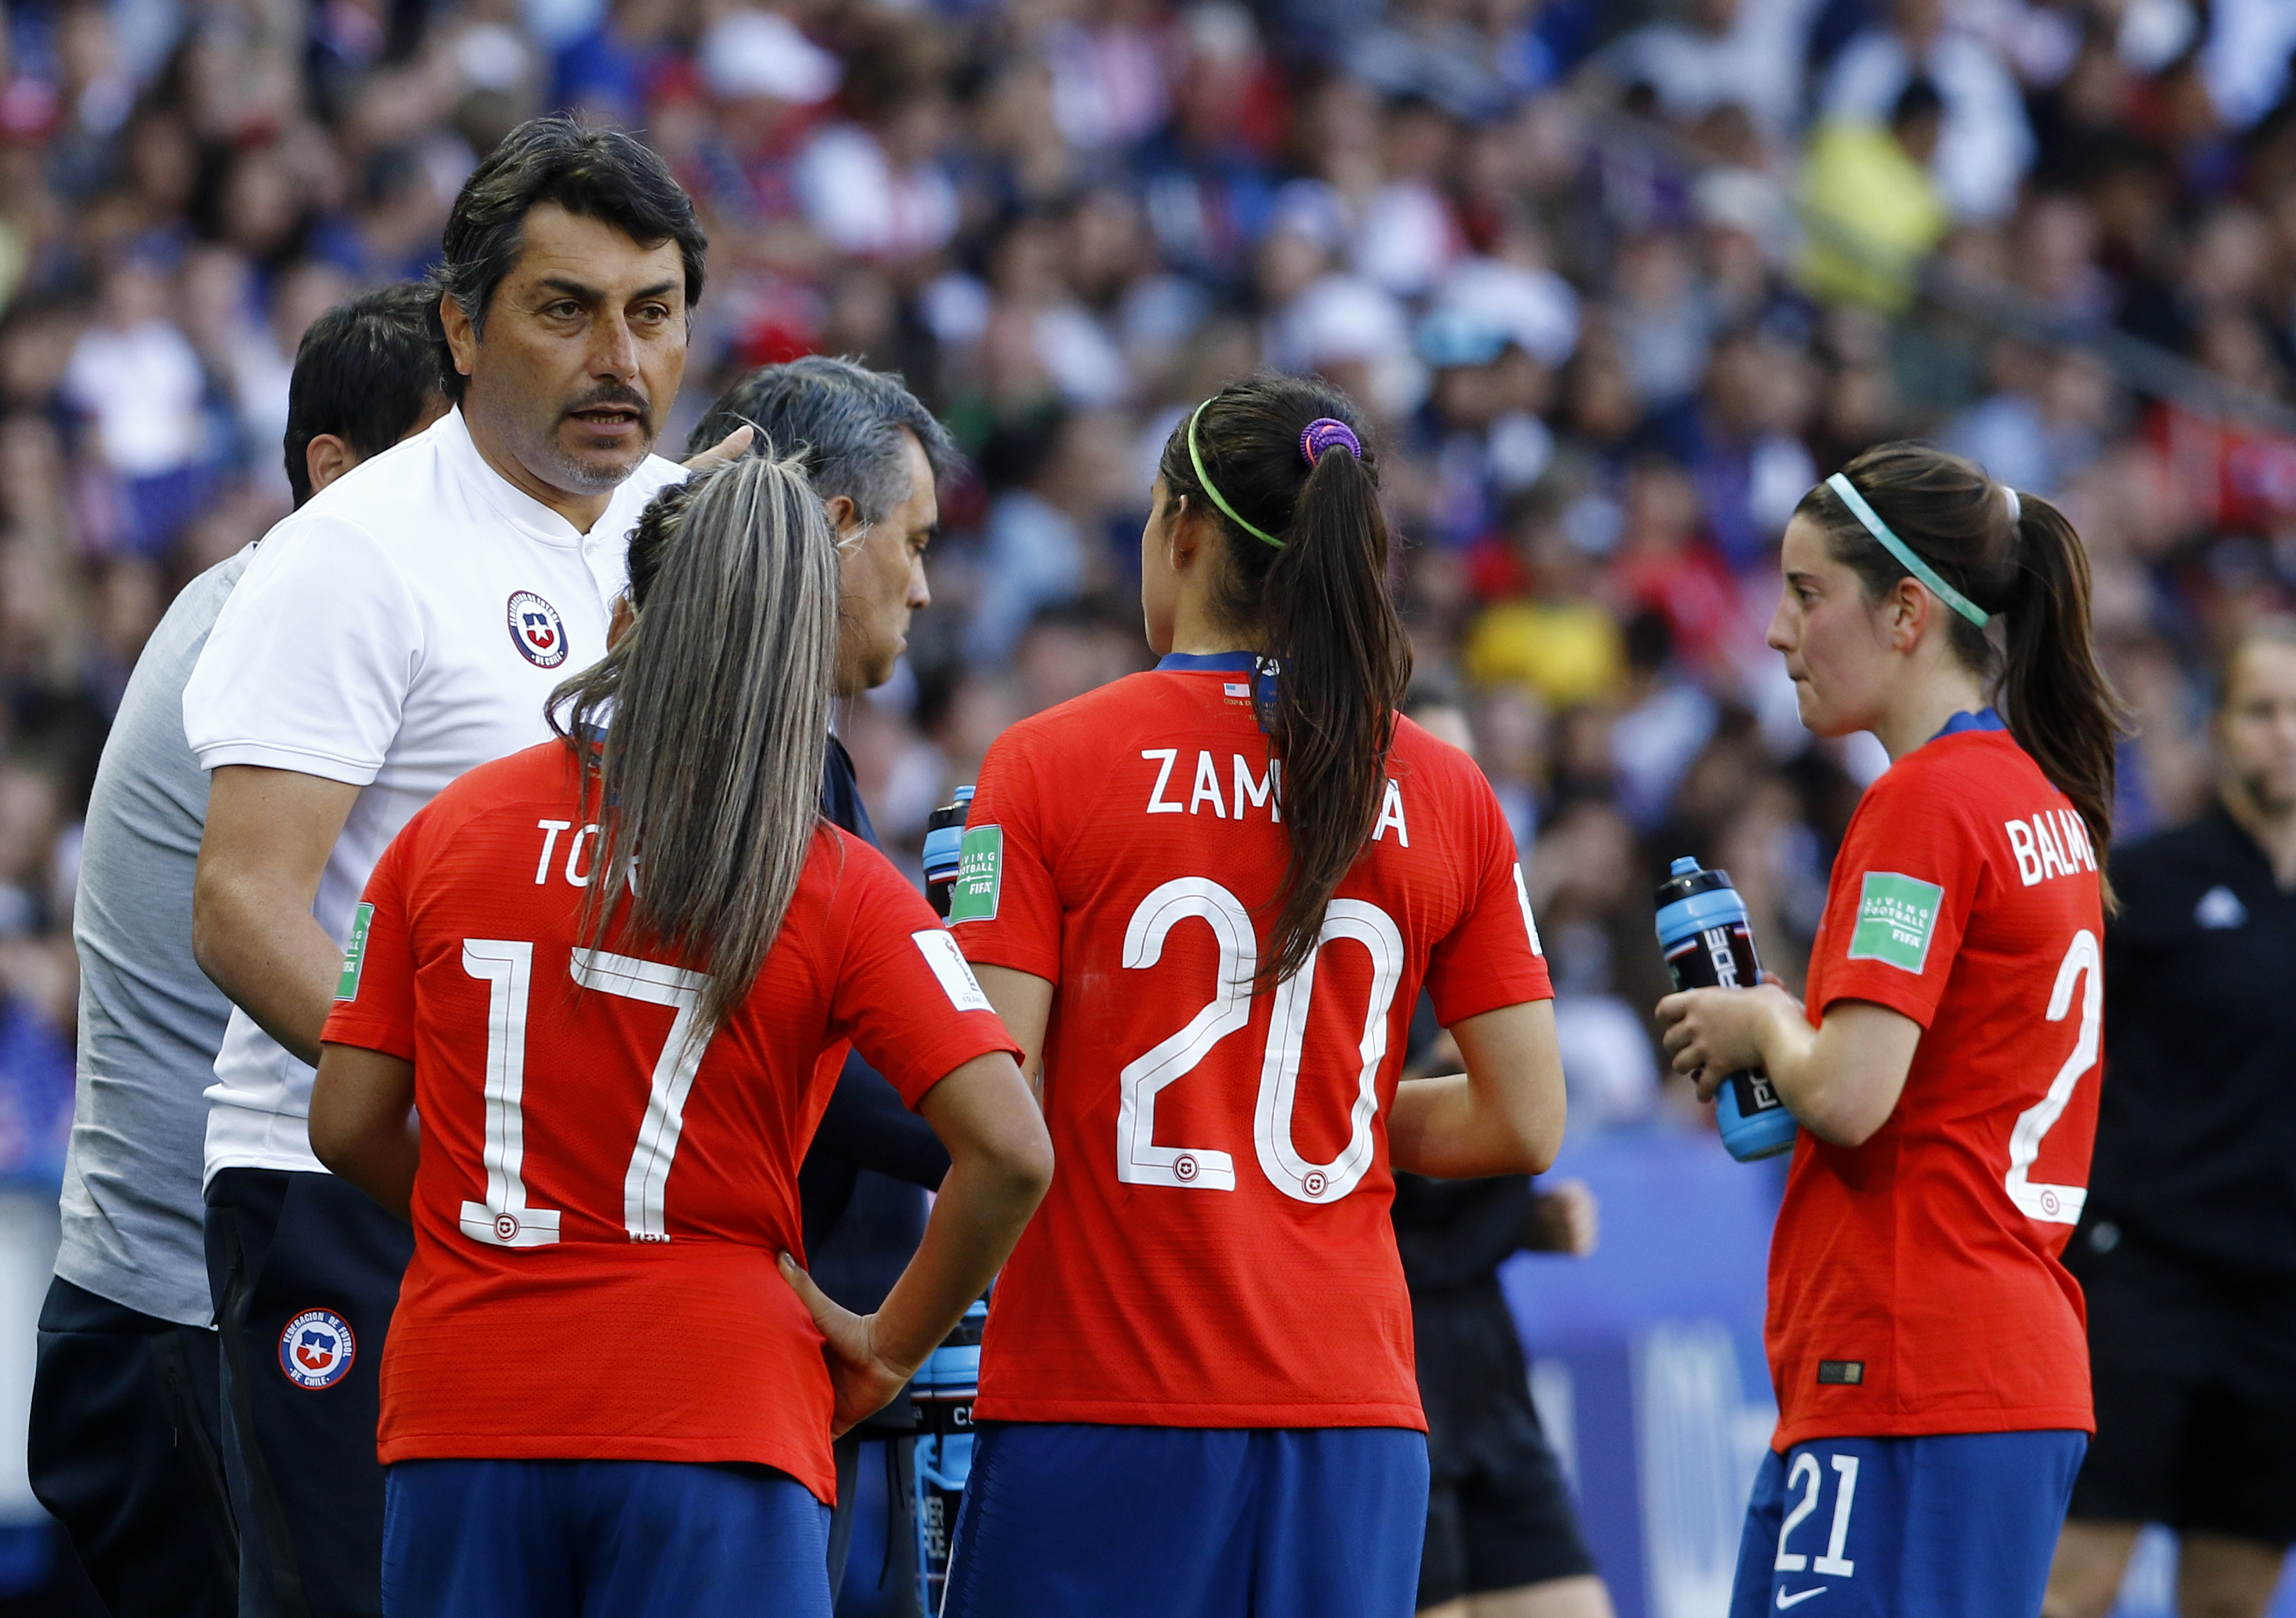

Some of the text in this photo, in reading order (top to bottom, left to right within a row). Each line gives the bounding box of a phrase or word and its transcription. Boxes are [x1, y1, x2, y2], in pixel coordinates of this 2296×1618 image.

[1141, 749, 1410, 848] ZAMA
[969, 881, 991, 895] FIFA
[1864, 906, 1925, 928] FOOTBALL
[1866, 896, 1929, 919] LIVING
[1891, 928, 1923, 949] FIFA
[1117, 876, 1405, 1204] 20
[460, 938, 718, 1247] 17
[283, 1312, 352, 1358] FEDERACION DE FUTBOL
[290, 1369, 327, 1387] DE CHILE
[1774, 1452, 1859, 1578] 21
